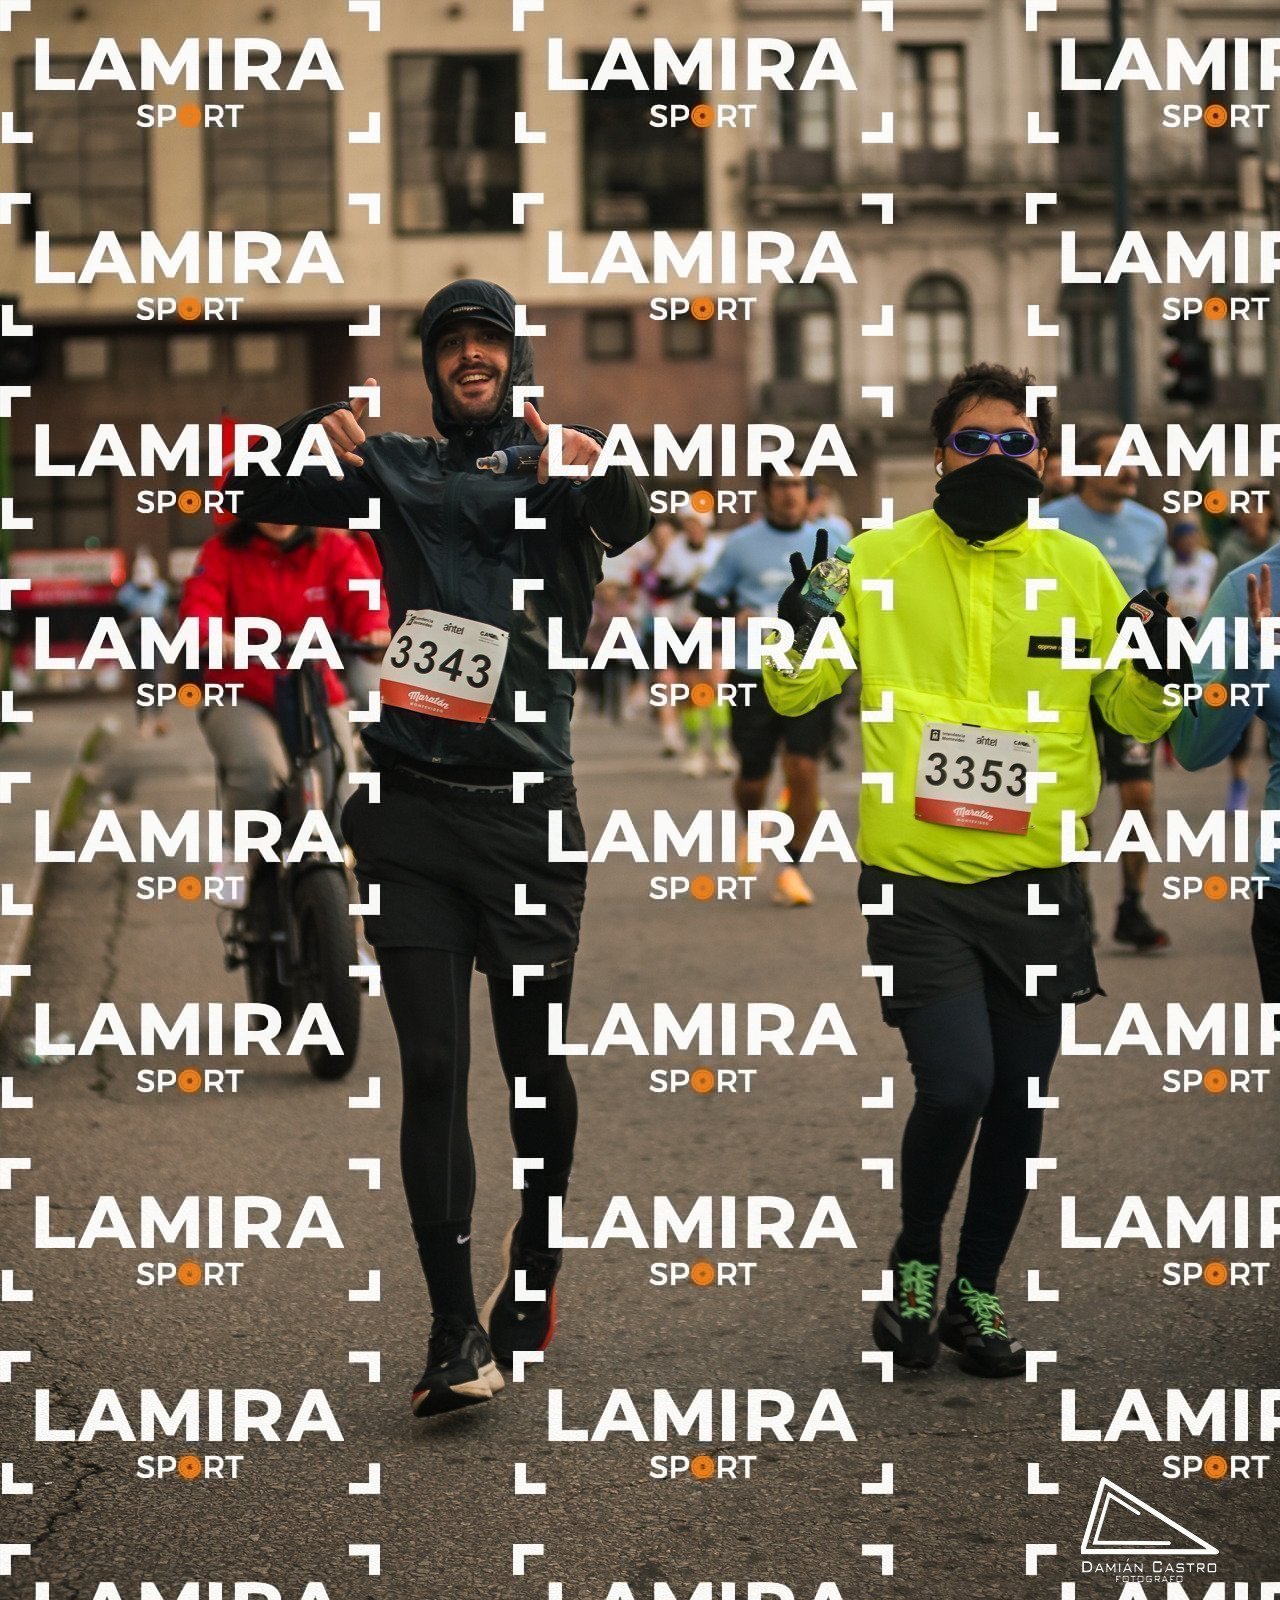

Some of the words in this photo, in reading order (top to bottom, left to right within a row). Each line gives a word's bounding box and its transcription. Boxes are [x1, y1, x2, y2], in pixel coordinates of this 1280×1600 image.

[443, 623, 465, 636] antel
[390, 635, 492, 689] 3343
[408, 691, 450, 710] Maratón
[976, 736, 998, 747] antel
[925, 752, 1027, 797] 3353
[953, 806, 994, 822] Maratón
